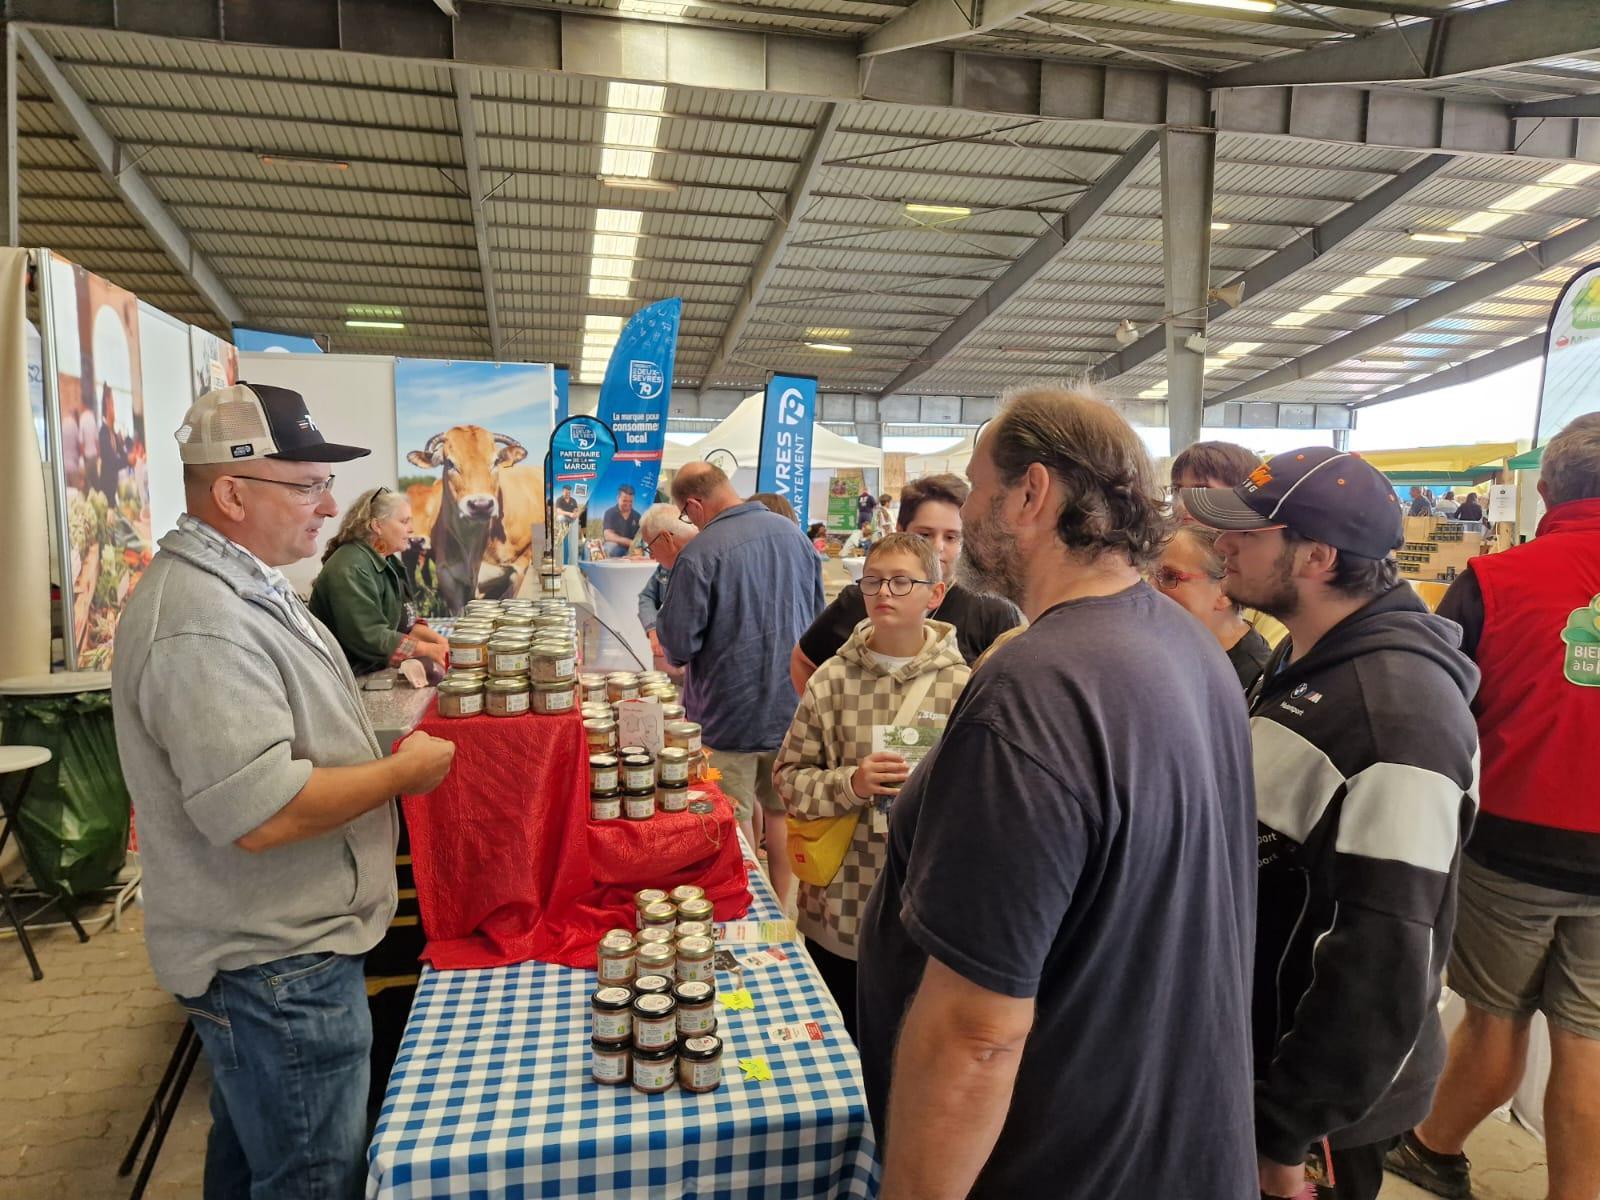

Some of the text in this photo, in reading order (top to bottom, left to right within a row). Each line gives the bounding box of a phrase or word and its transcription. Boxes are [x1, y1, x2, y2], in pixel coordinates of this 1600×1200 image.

[639, 382, 652, 395] 79
[613, 413, 620, 421] La
[621, 414, 645, 422] marque
[626, 432, 648, 443] local
[559, 450, 601, 458] PARTENAIRE
[1574, 646, 1600, 659] BIE
[1582, 661, 1594, 672] la
